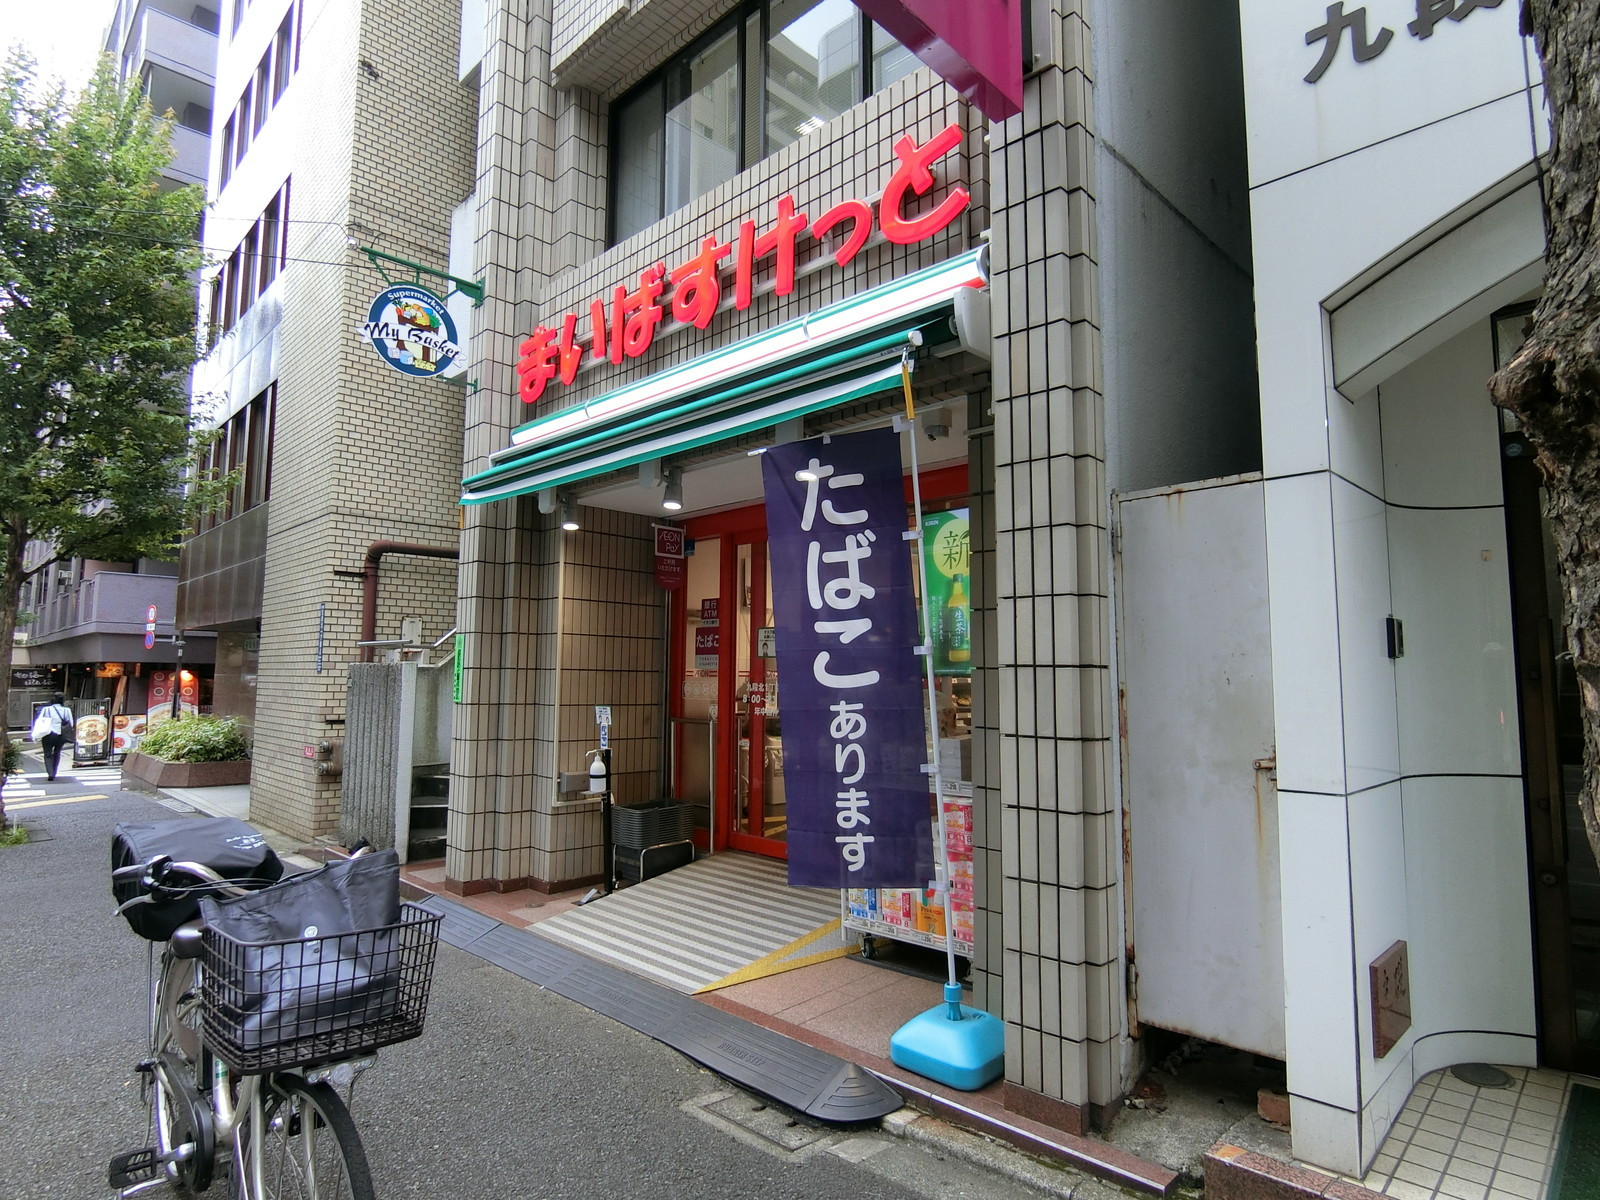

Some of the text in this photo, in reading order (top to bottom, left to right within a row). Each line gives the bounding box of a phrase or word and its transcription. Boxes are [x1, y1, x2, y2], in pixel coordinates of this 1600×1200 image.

[516, 122, 971, 404] まいばすけっと
[387, 290, 445, 315] Supermarket
[363, 321, 460, 360] My Basket
[665, 542, 680, 553] Pay
[703, 609, 718, 618] ATM
[954, 609, 966, 635] 生茶
[744, 1054, 767, 1067] STEP
